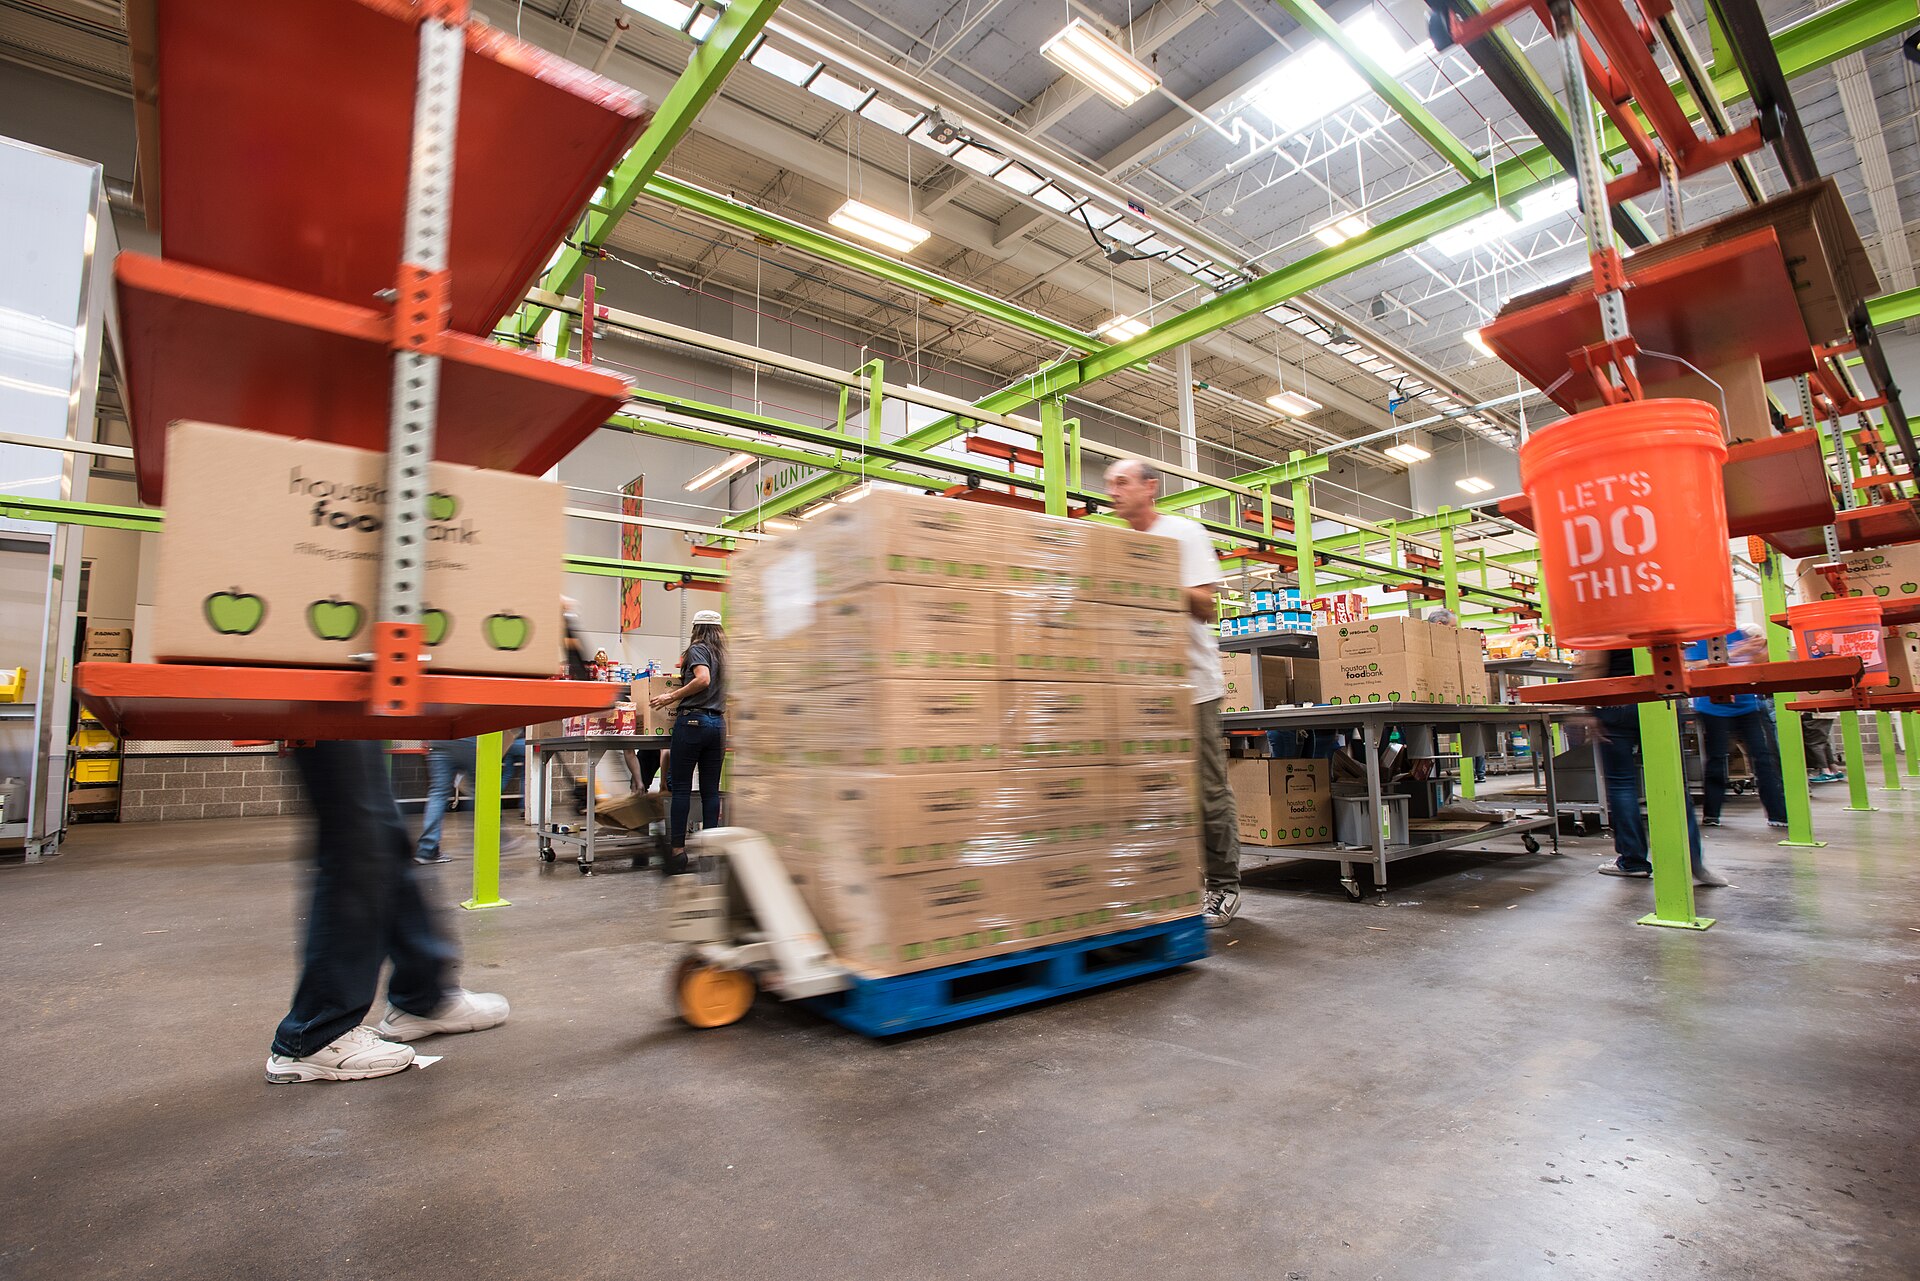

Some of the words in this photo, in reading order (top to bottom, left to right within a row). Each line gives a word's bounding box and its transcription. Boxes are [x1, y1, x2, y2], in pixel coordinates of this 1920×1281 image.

[1557, 470, 1652, 513] LET'S
[1562, 504, 1658, 567] DO
[1568, 561, 1675, 602] THIS.
[1341, 664, 1367, 672] houston
[1346, 669, 1383, 679] foodbank
